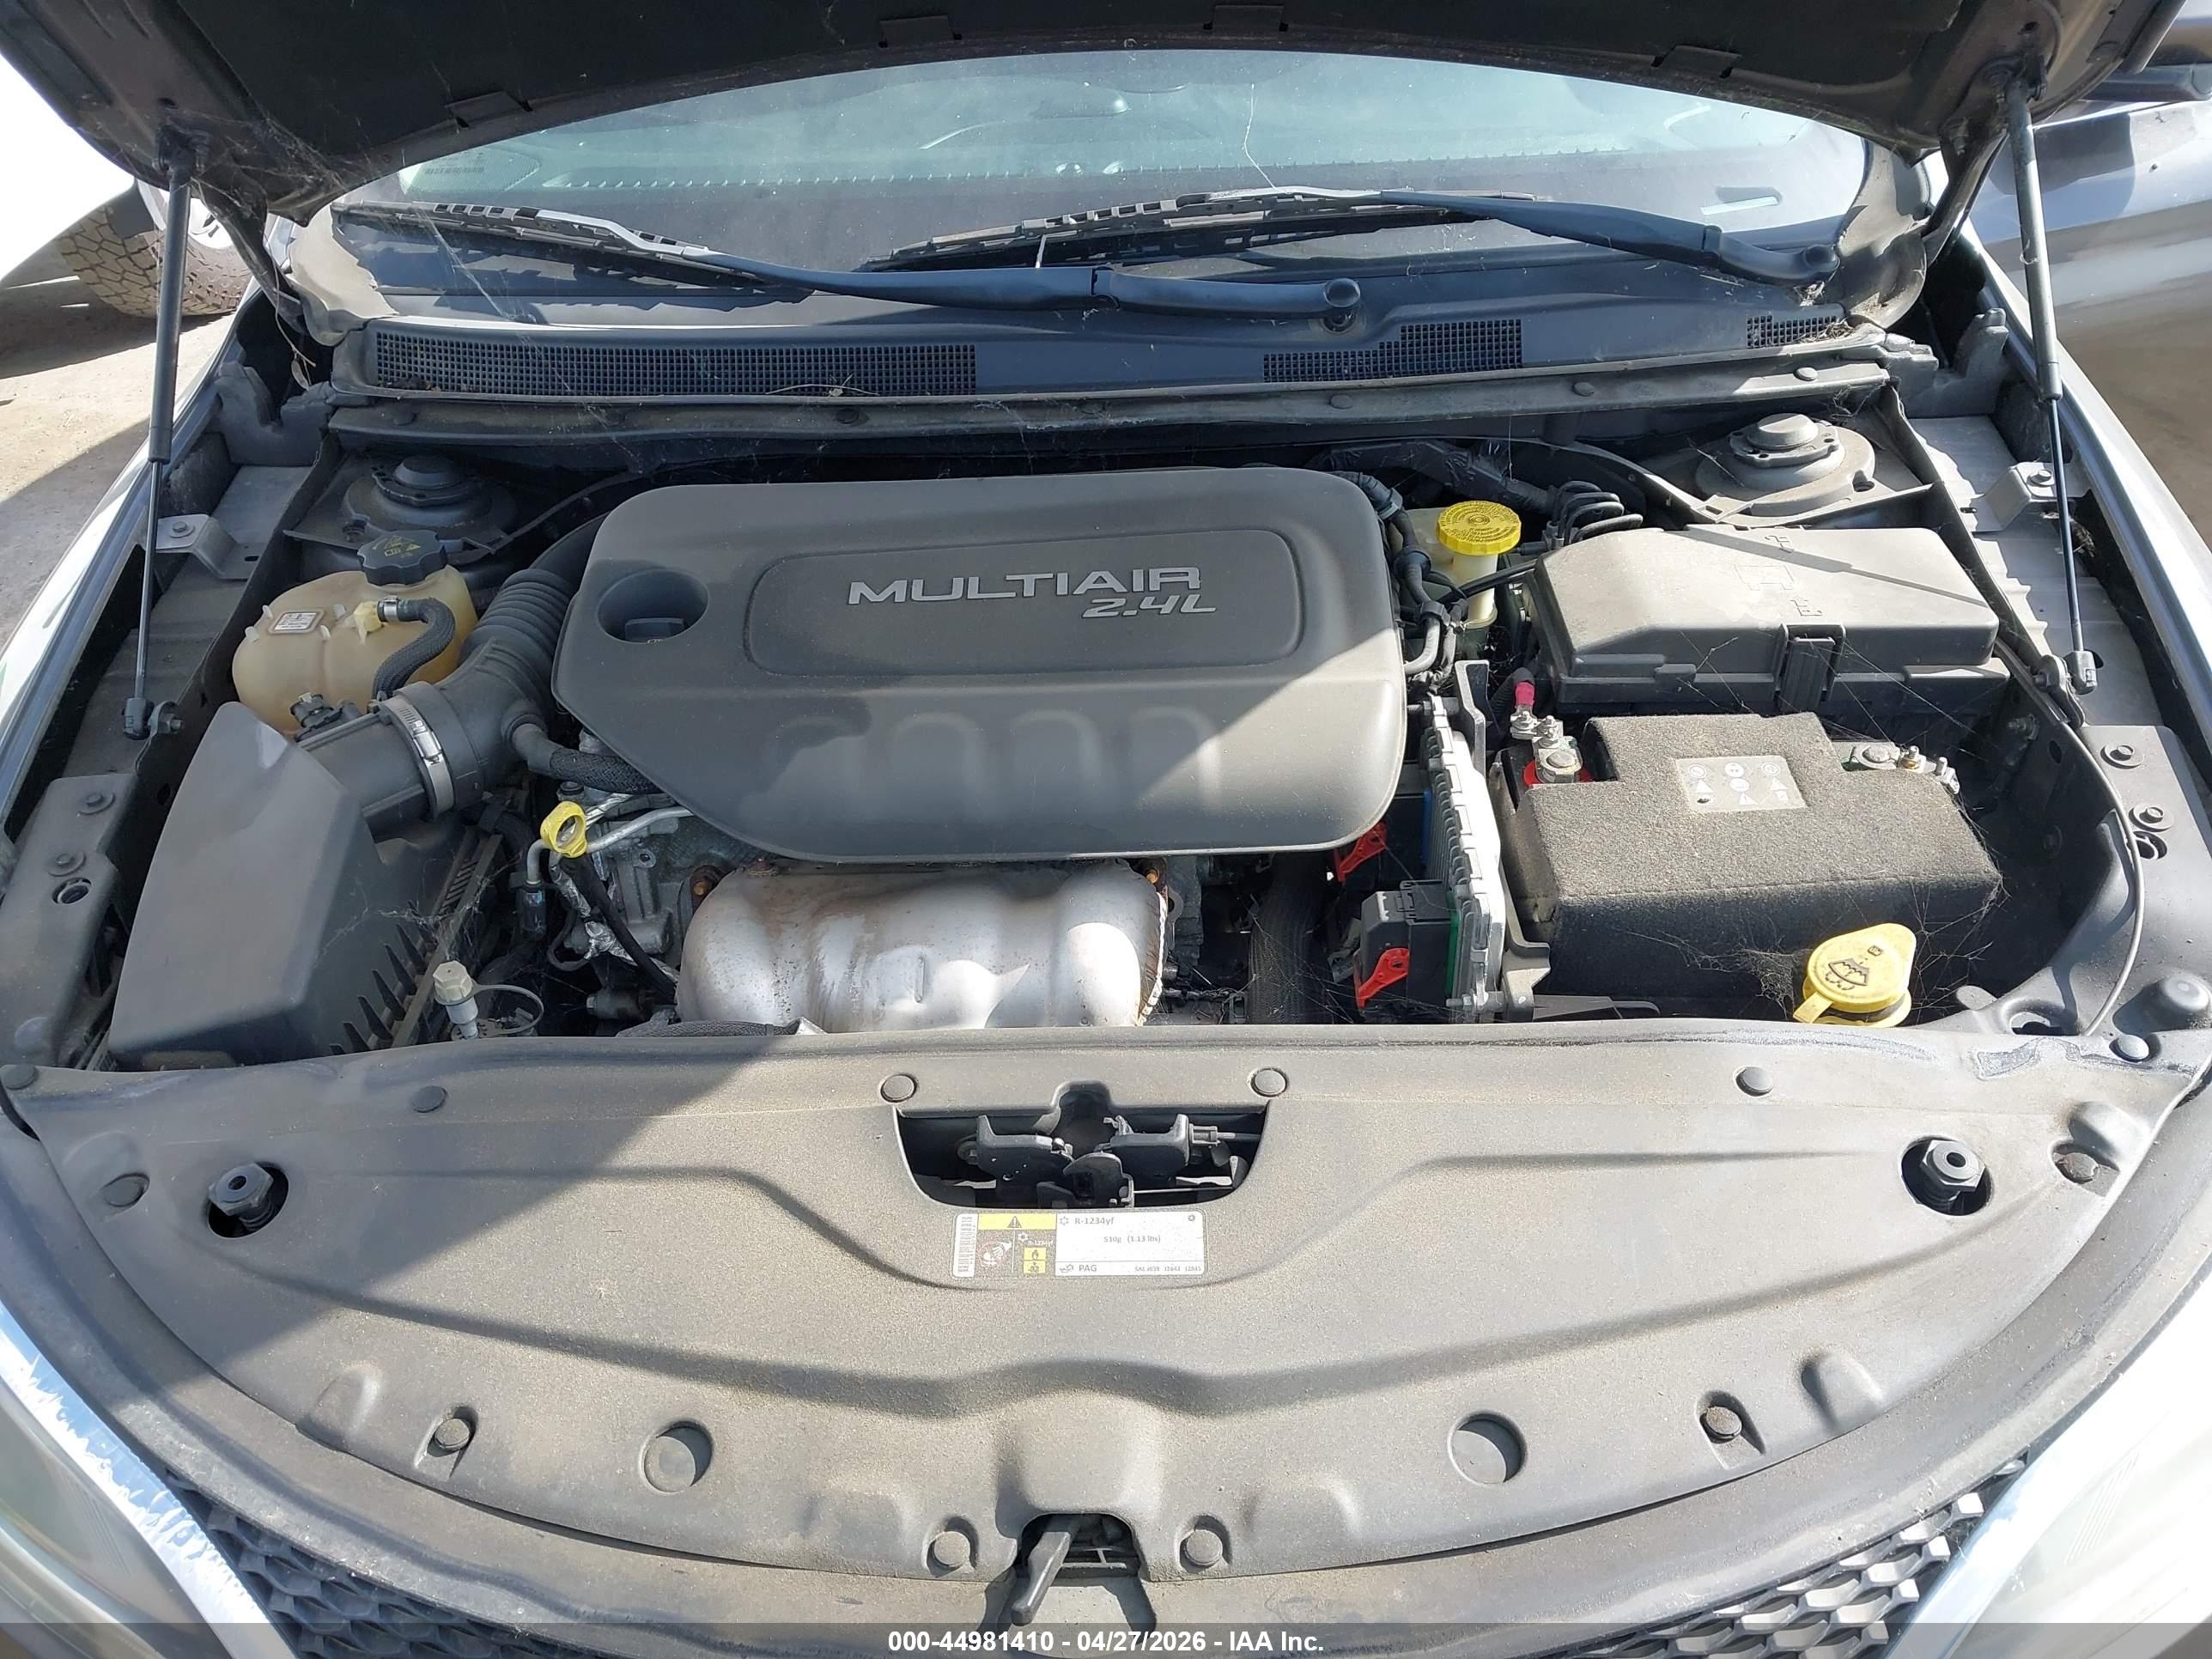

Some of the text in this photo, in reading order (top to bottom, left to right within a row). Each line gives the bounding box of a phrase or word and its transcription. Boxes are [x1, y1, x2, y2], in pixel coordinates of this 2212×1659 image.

[848, 567, 1200, 605] MULTIAIR
[1081, 592, 1217, 618] 2.4L
[1074, 1216, 1115, 1225] R-1234yf
[1079, 1264, 1097, 1273] PAG
